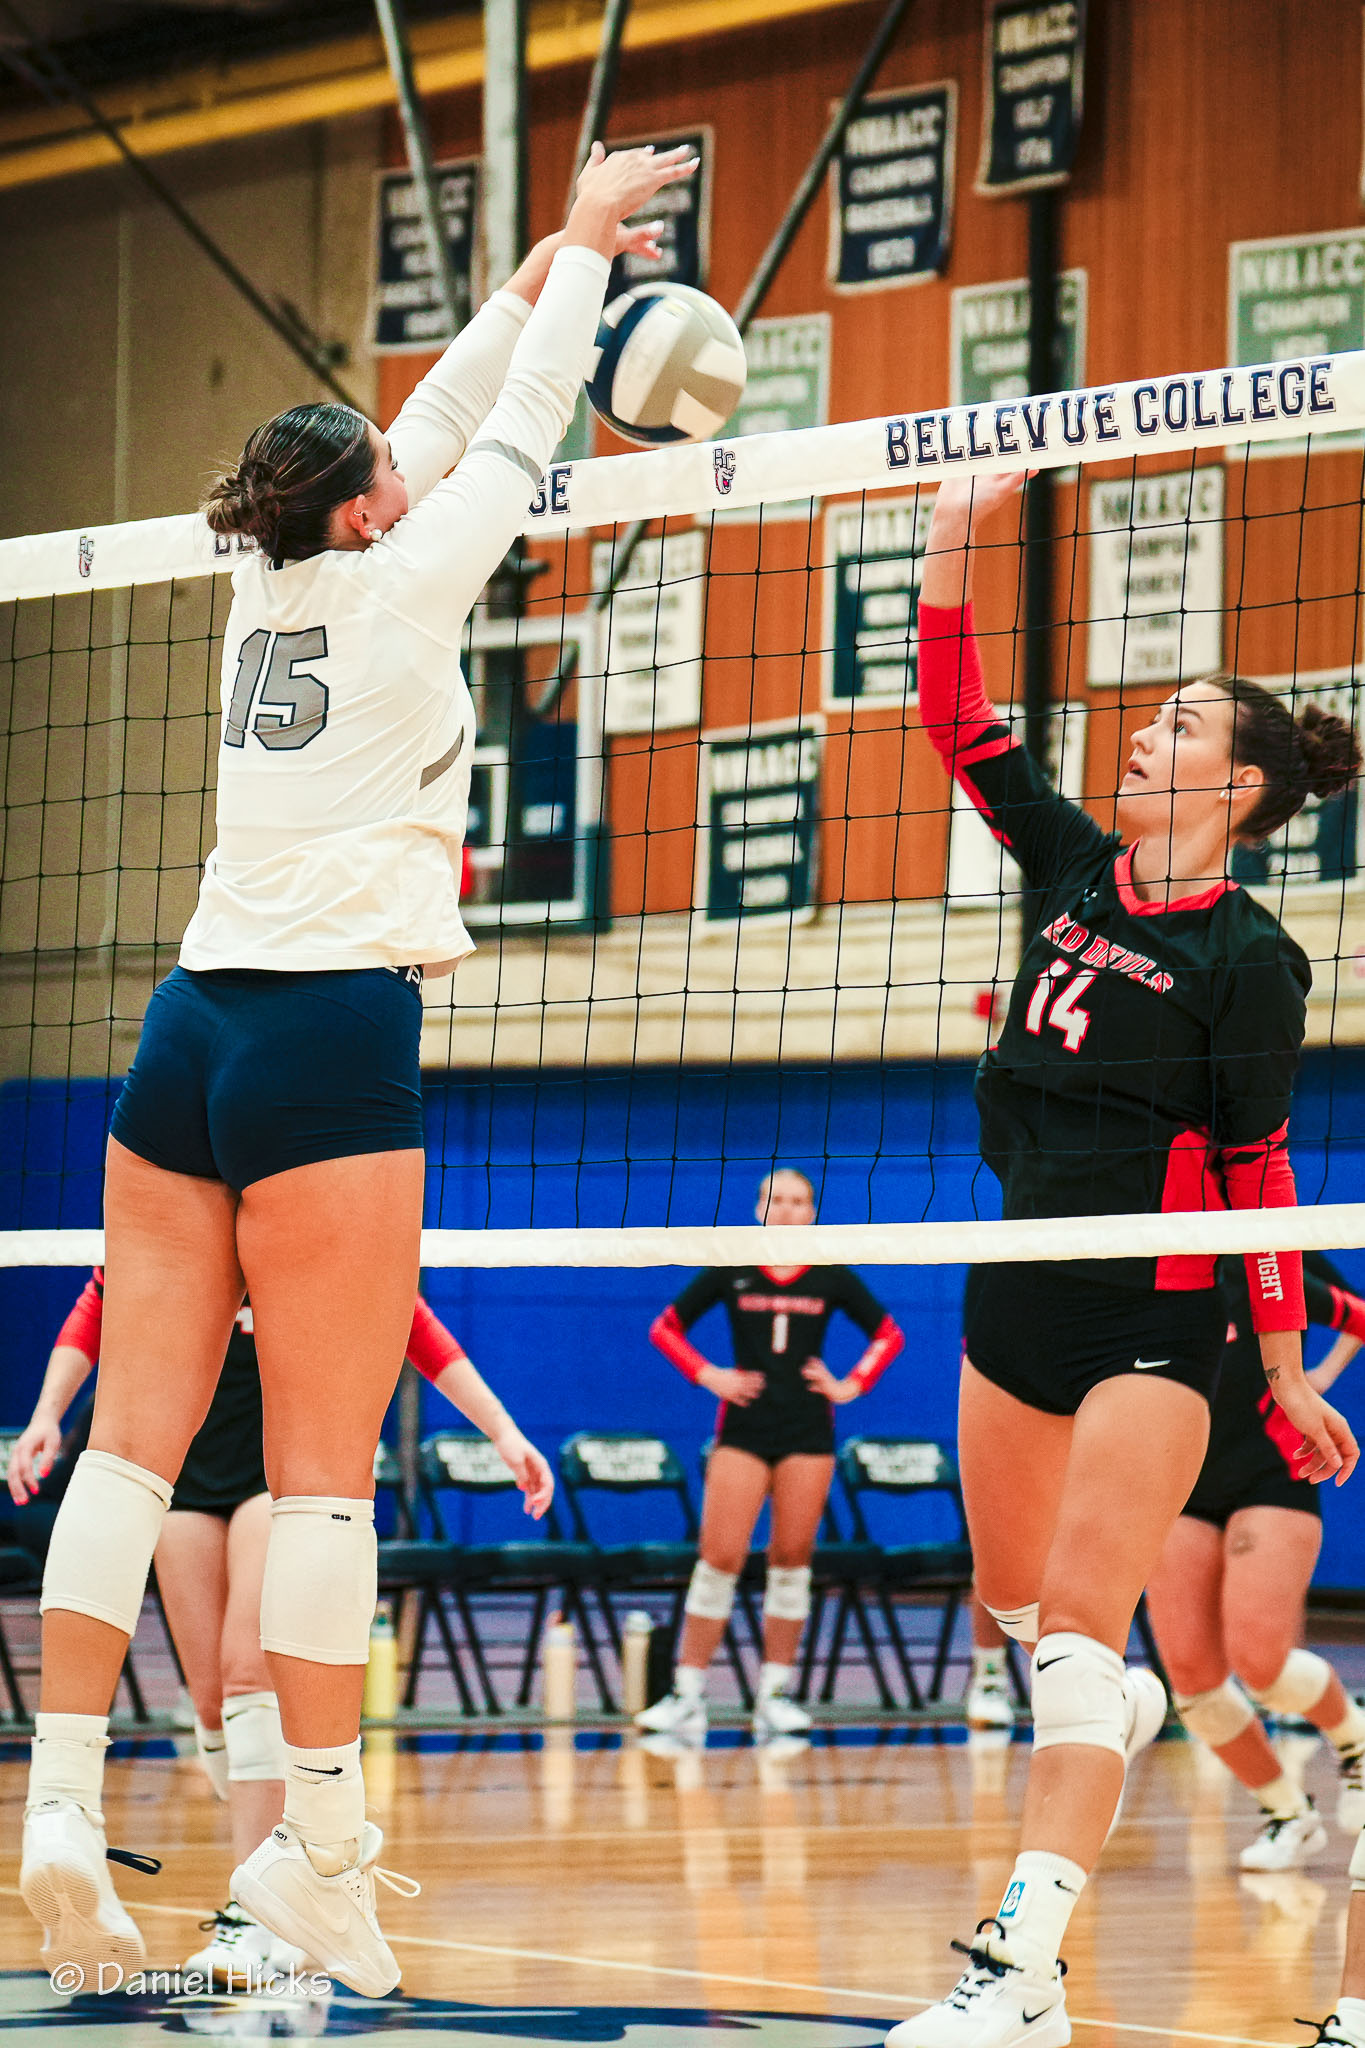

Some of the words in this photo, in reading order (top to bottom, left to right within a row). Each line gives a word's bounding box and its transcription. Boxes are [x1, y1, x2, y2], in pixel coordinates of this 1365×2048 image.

[885, 387, 1122, 470] BELLEVUE
[1132, 358, 1337, 437] COLLEGE
[224, 625, 329, 750] 15
[1025, 957, 1100, 1054] 14
